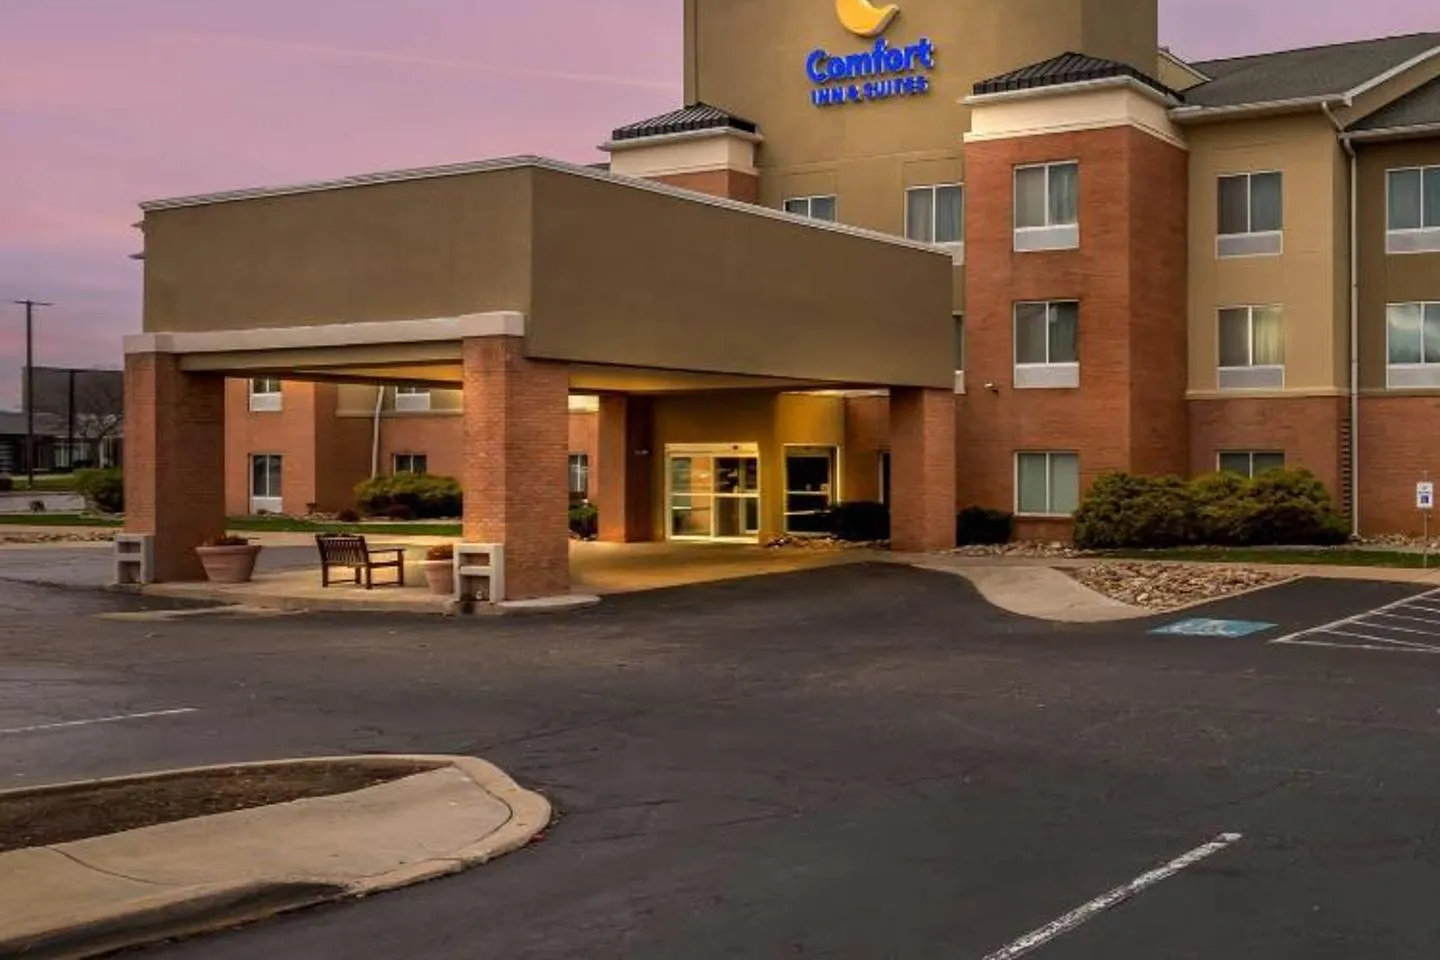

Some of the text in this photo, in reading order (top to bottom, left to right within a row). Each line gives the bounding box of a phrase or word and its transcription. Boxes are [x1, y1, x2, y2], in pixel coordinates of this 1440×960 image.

[806, 36, 934, 83] Comfort
[812, 87, 846, 106] INN
[863, 75, 929, 100] SUITES
